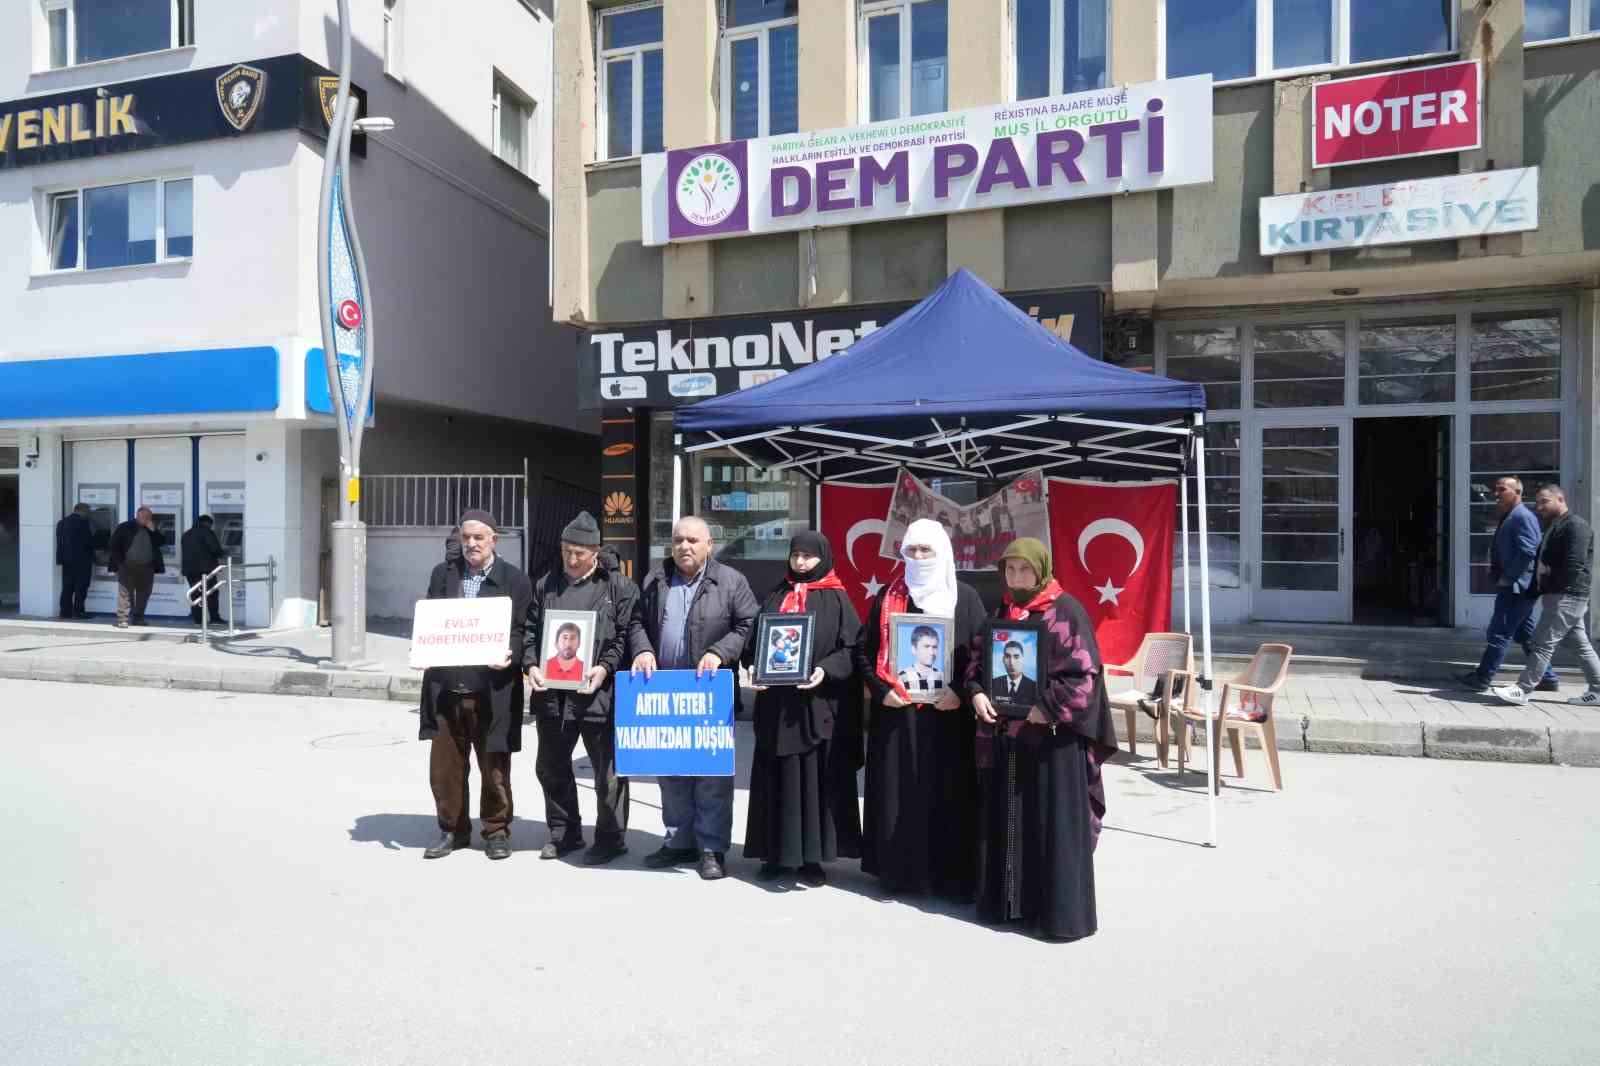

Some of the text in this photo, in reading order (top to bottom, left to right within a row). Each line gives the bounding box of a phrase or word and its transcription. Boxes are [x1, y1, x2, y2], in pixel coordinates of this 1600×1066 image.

[993, 122, 1030, 138] MUŞ
[1035, 118, 1049, 132] İL
[1323, 89, 1469, 140] NOTER
[770, 97, 1166, 218] DEM PARTİ
[772, 128, 966, 165] HALKLARIN EŞİTLİK VE DEMOKRASİ PARTİSİ
[1267, 198, 1524, 246] KIRTASİYE
[635, 691, 670, 716] ARTIK
[671, 691, 707, 716] YETER
[616, 725, 692, 750] YAKAMIZDAN
